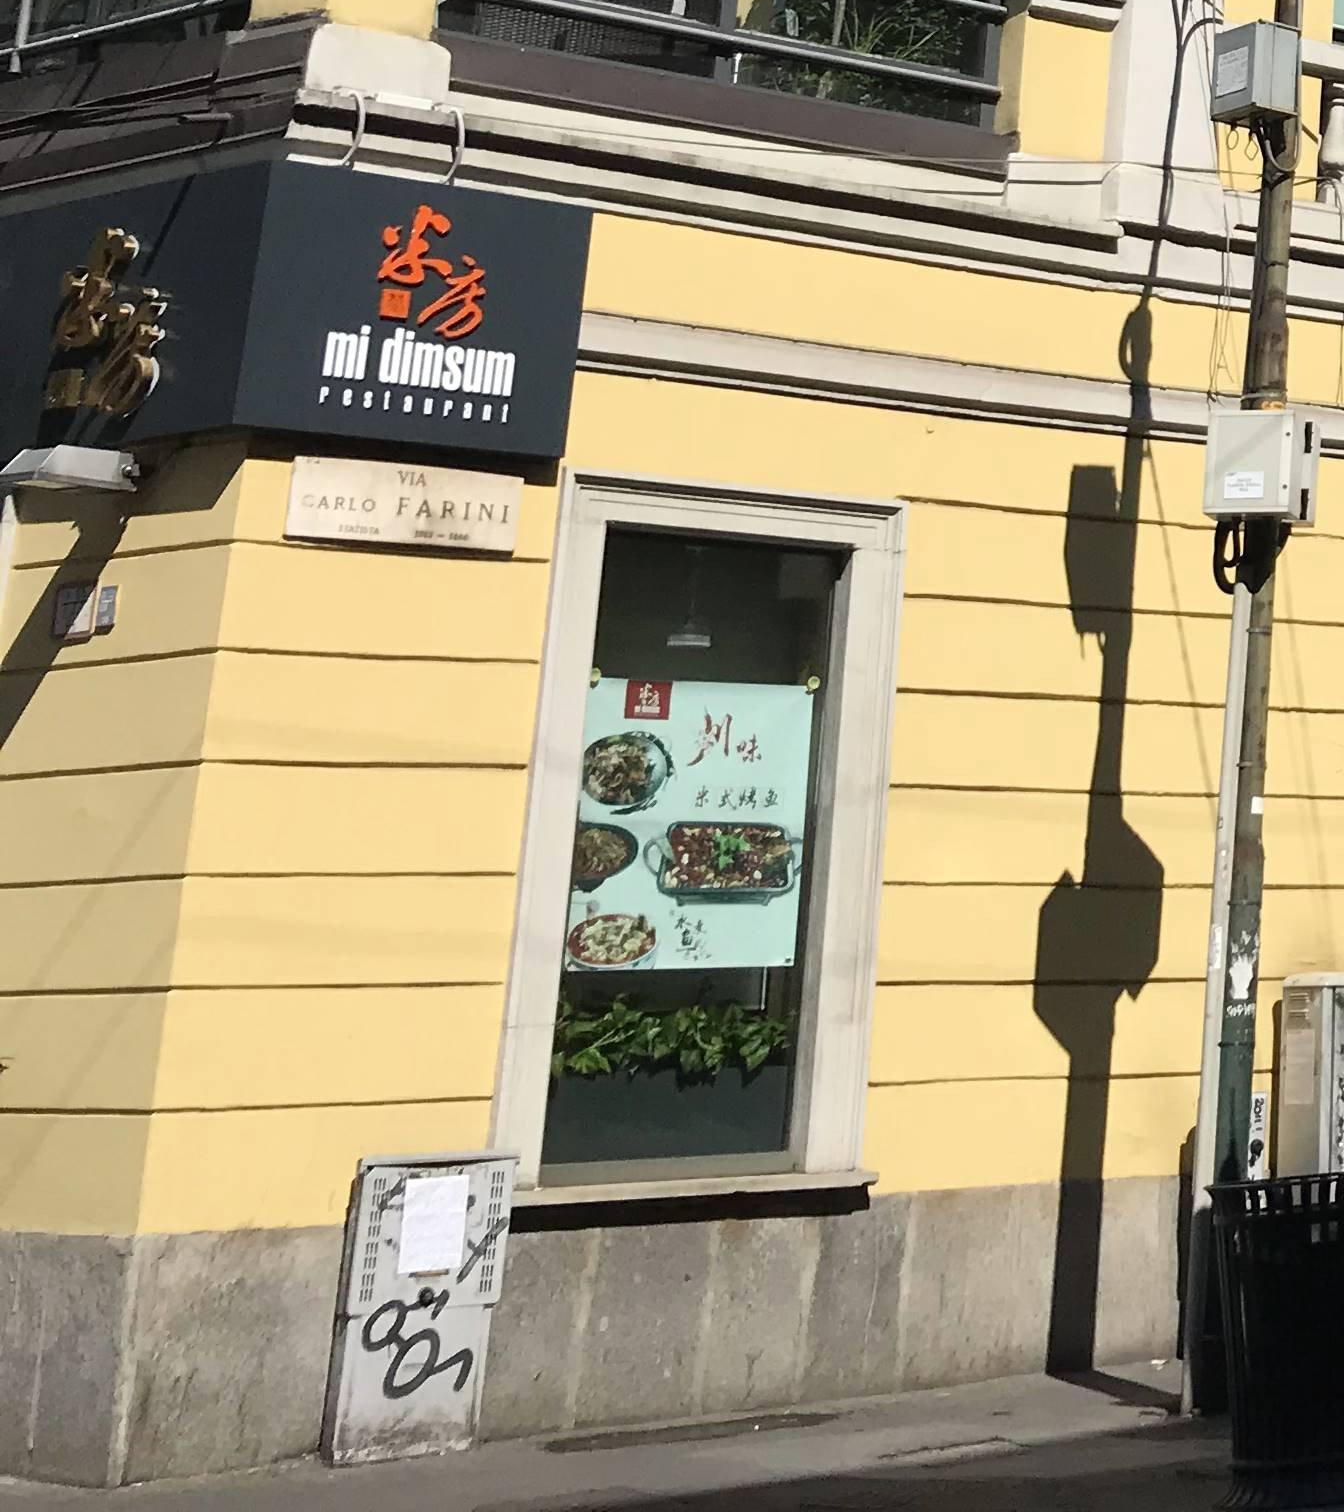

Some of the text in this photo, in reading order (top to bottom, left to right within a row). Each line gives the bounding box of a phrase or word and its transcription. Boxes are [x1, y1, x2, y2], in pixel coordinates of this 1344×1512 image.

[321, 324, 516, 397] mi dimsum
[318, 386, 510, 424] restaurant
[397, 470, 428, 487] VIA
[302, 493, 510, 524] CARLO FARINI
